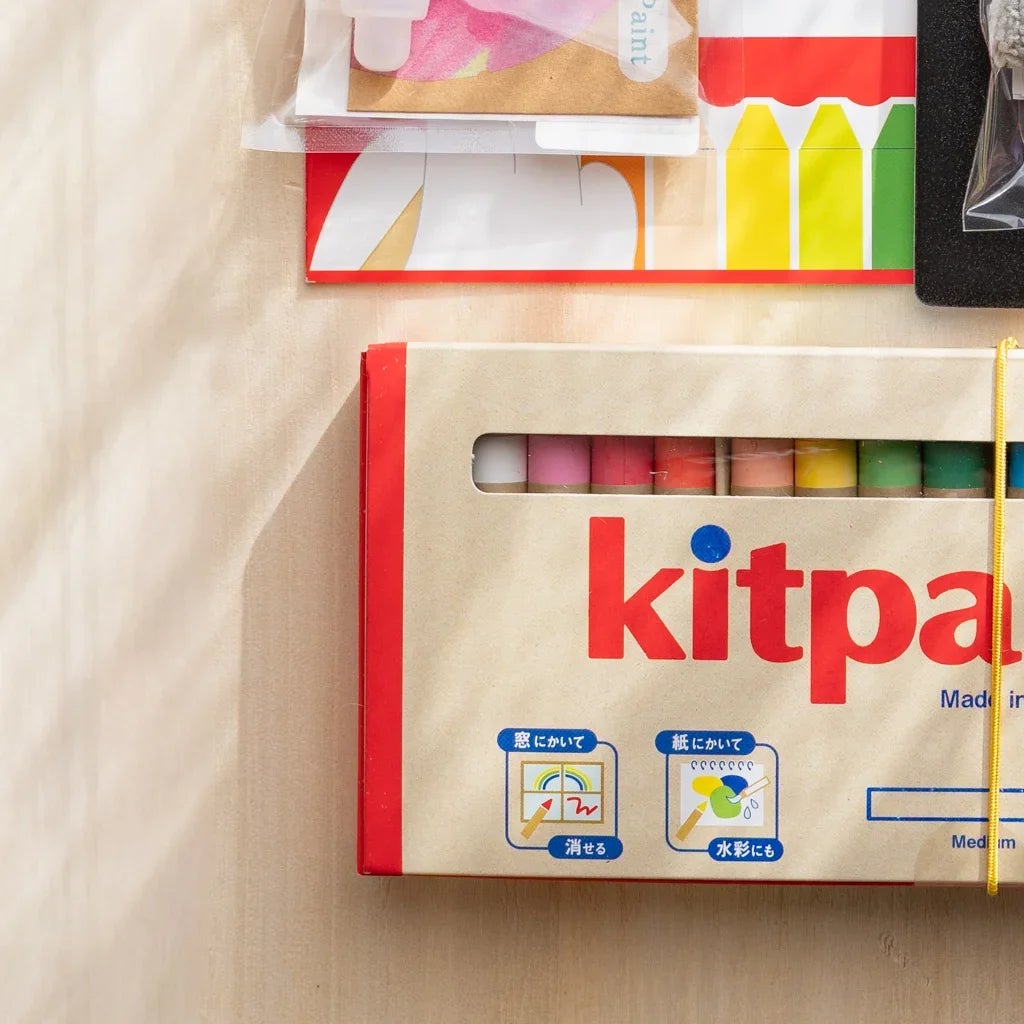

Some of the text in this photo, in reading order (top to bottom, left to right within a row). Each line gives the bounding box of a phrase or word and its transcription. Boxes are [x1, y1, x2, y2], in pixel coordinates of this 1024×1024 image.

[514, 731, 585, 750] 窓にかいて
[672, 734, 743, 752] 紙にかいて
[565, 838, 606, 856] 消せる
[716, 841, 775, 858] 水彩にも
